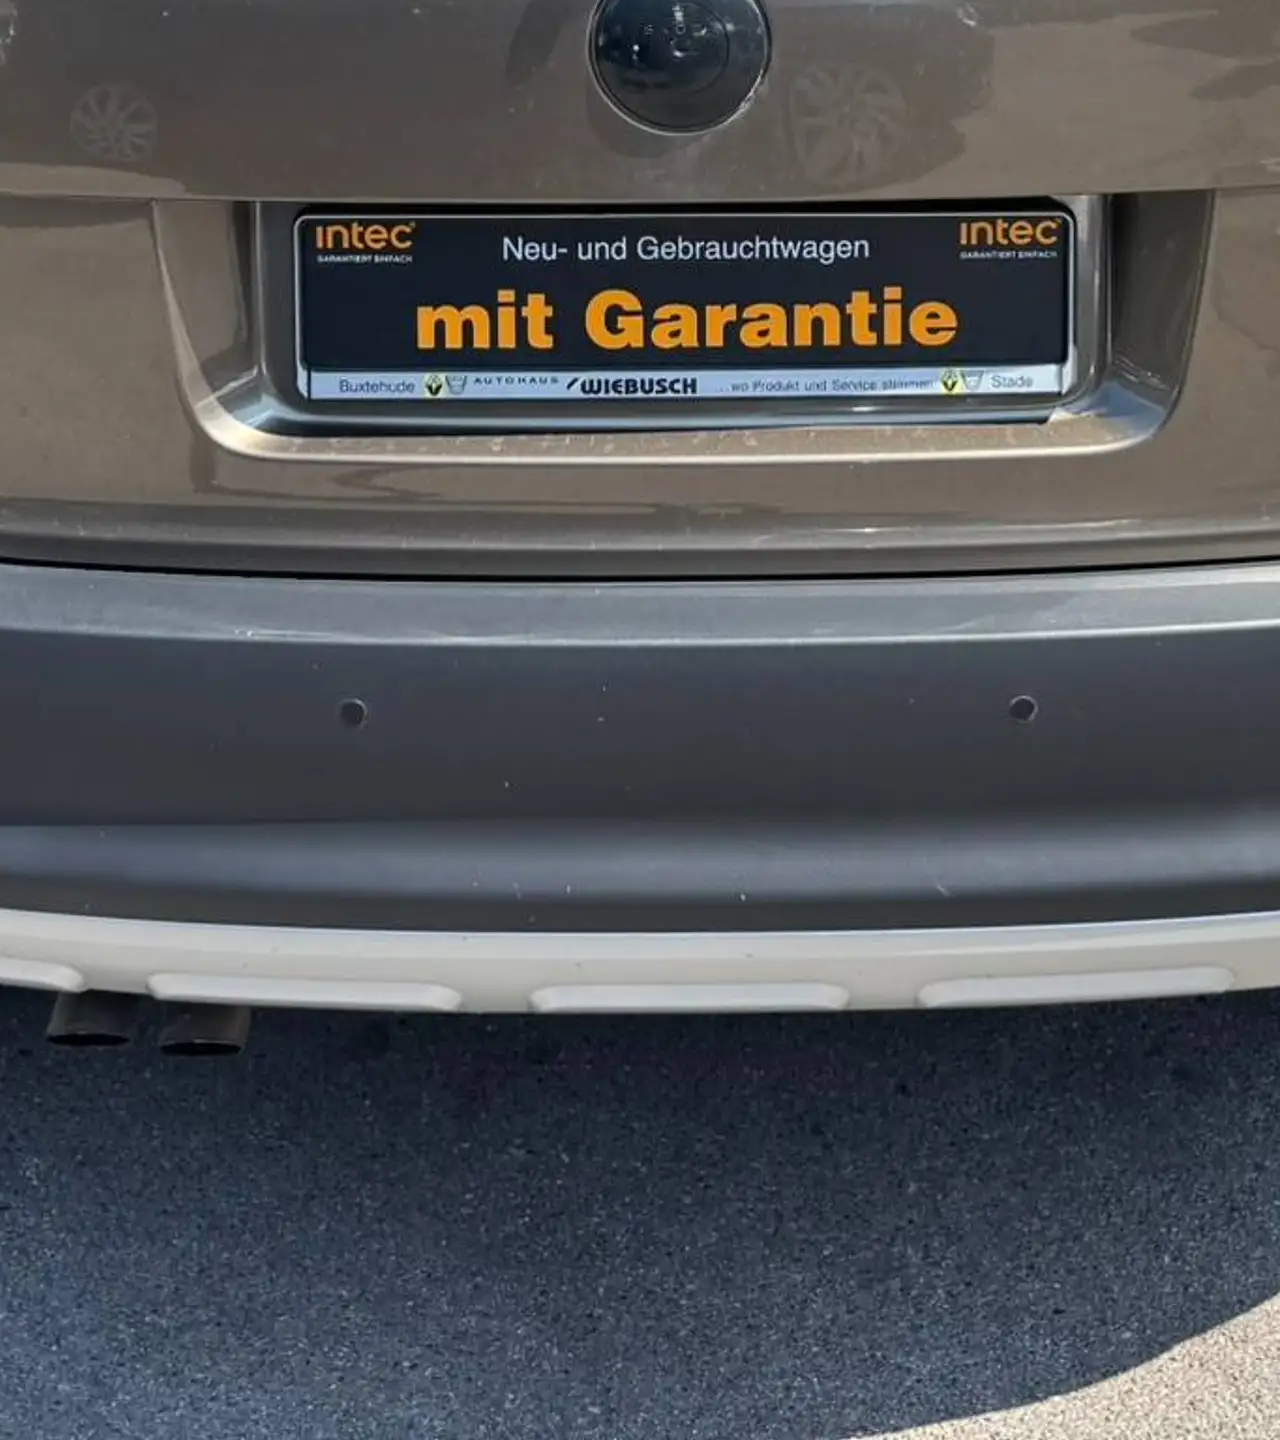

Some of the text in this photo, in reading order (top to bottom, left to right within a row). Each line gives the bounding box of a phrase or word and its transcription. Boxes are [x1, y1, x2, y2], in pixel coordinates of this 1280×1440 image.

[315, 221, 414, 249] intec
[959, 218, 1058, 246] intec
[502, 234, 871, 265] Neu- und Gebrauchtwagen
[416, 286, 959, 350] mit Garantie
[338, 378, 416, 394] Buxtehude
[473, 375, 560, 386] AUTOHAUS
[580, 376, 698, 396] WIEBUSCH
[804, 379, 827, 392] und
[990, 374, 1033, 389] Stade
